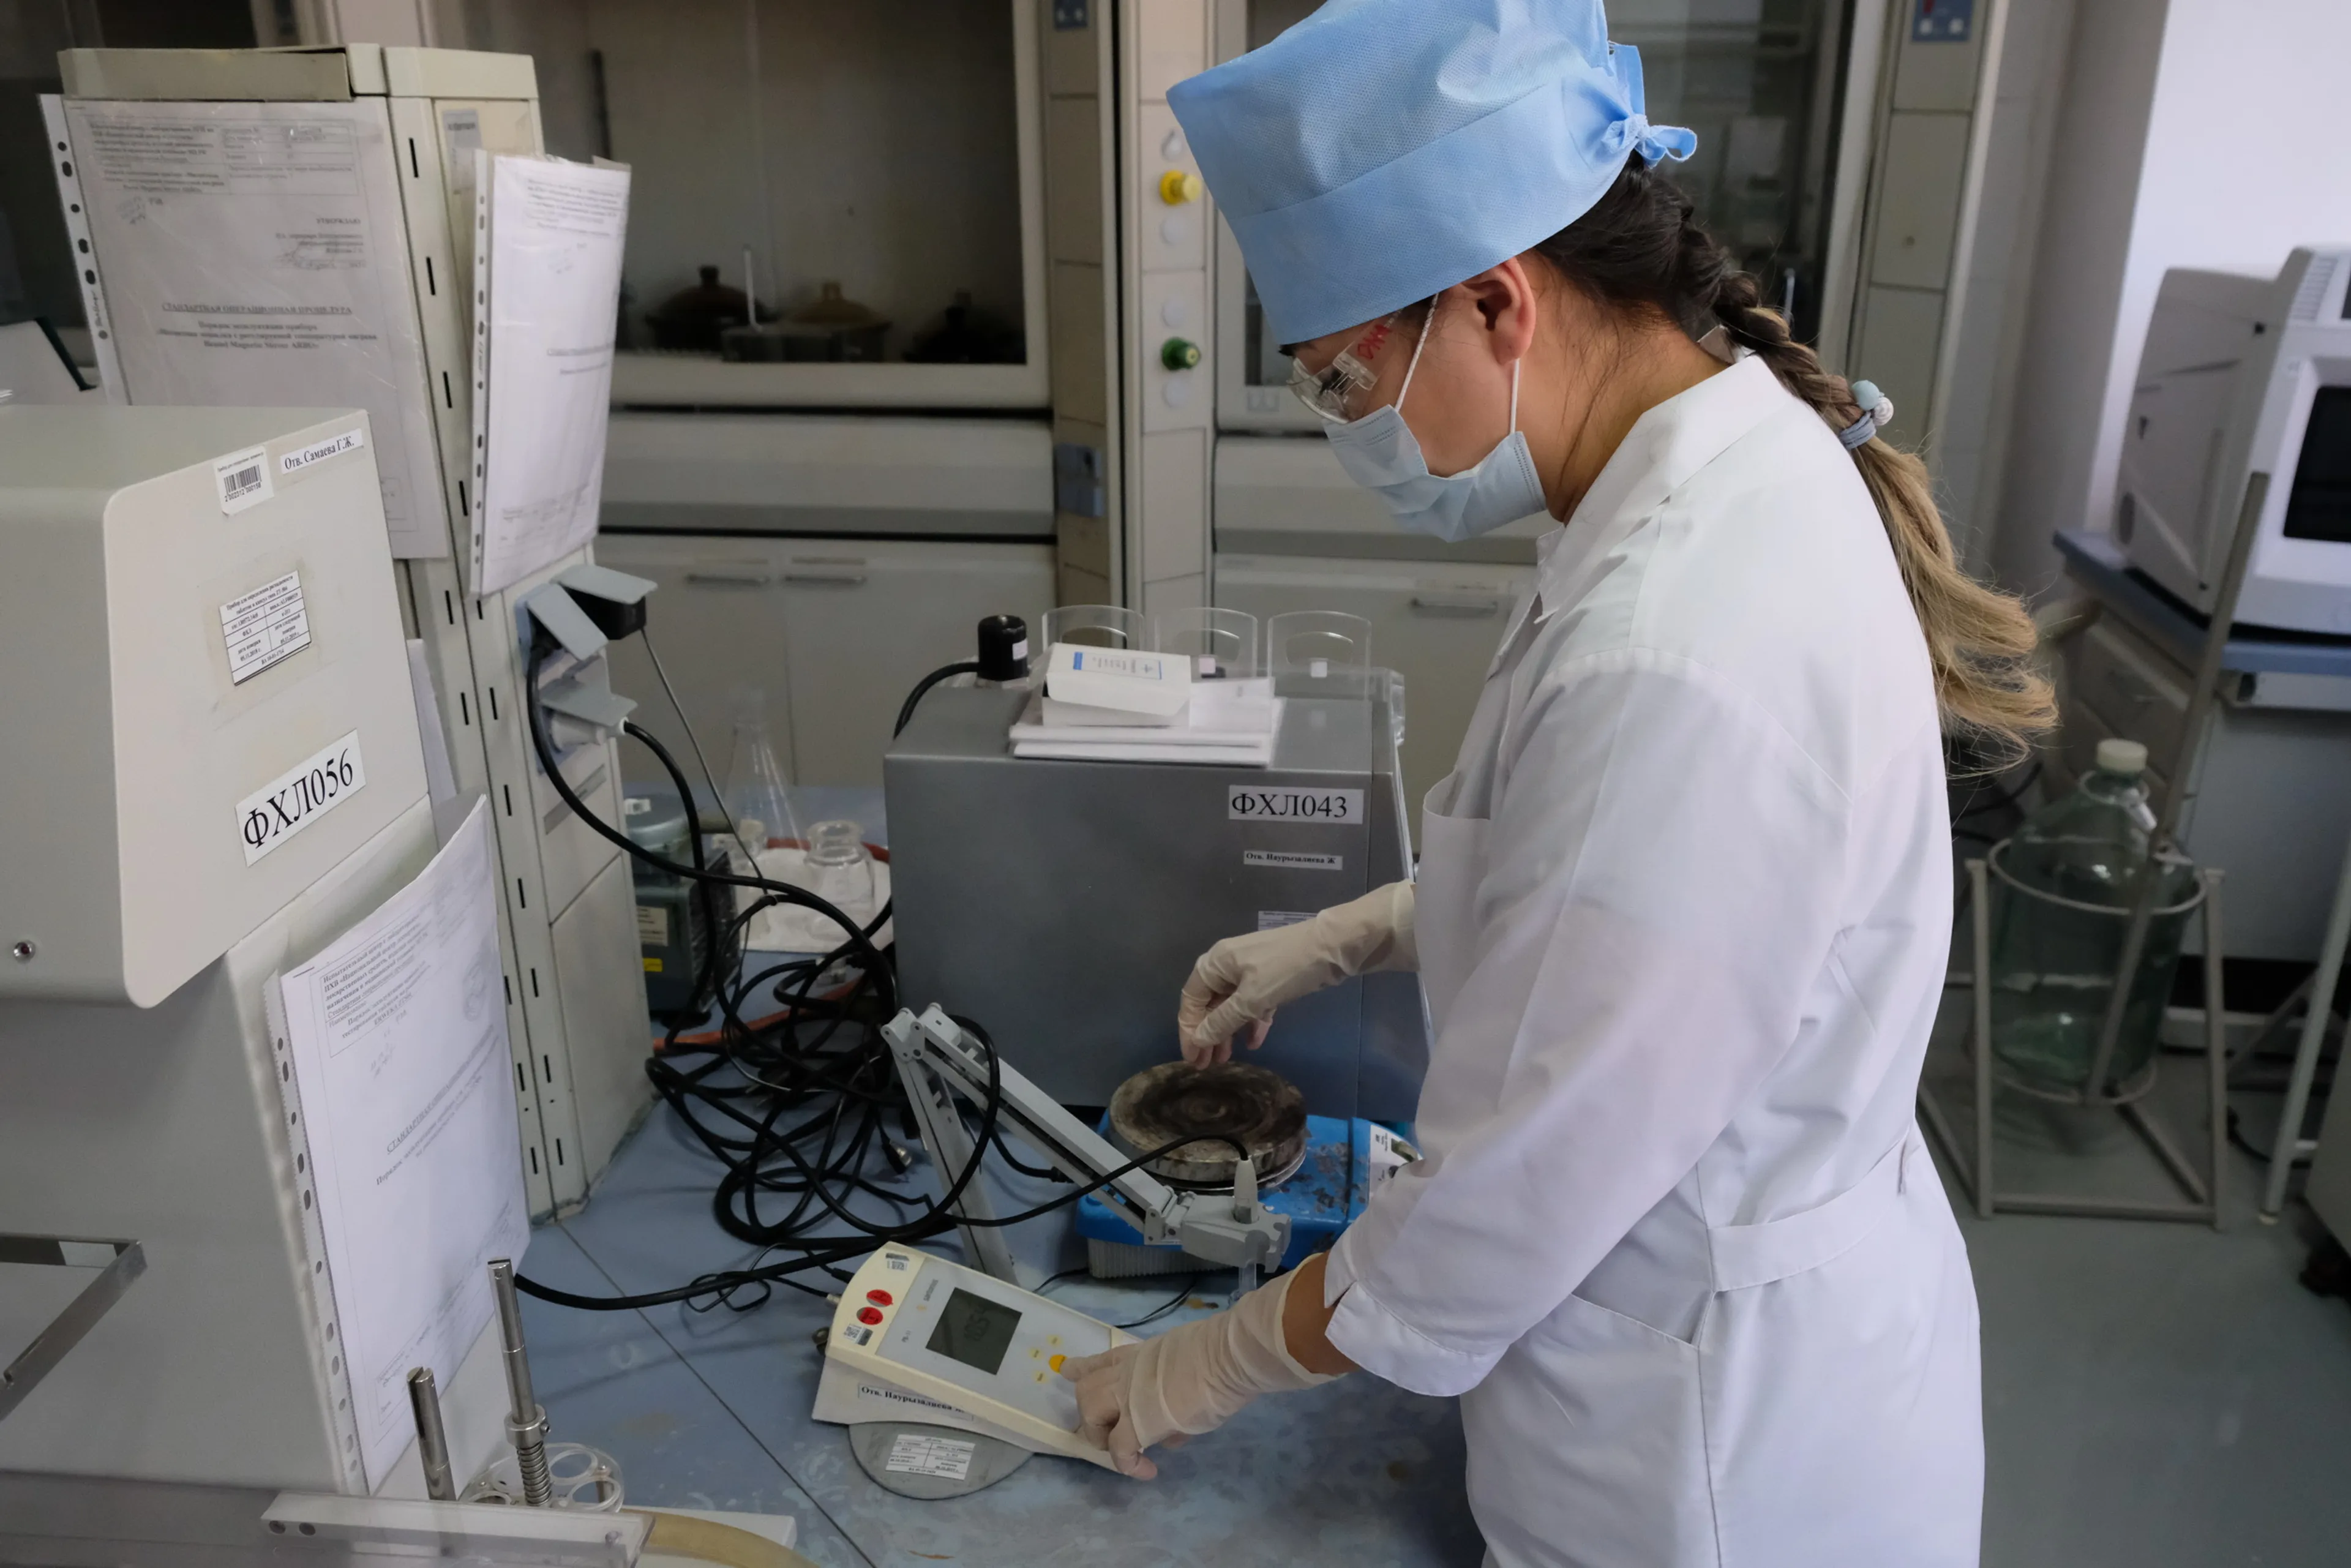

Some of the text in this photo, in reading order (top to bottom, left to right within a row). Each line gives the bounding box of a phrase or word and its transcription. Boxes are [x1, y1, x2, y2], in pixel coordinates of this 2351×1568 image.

[285, 456, 303, 470] Отв.
[304, 445, 336, 463] Самаева
[244, 748, 353, 849] ФХЛ056
[1232, 793, 1347, 818] ФХЛ043
[861, 1386, 882, 1397] Отв.
